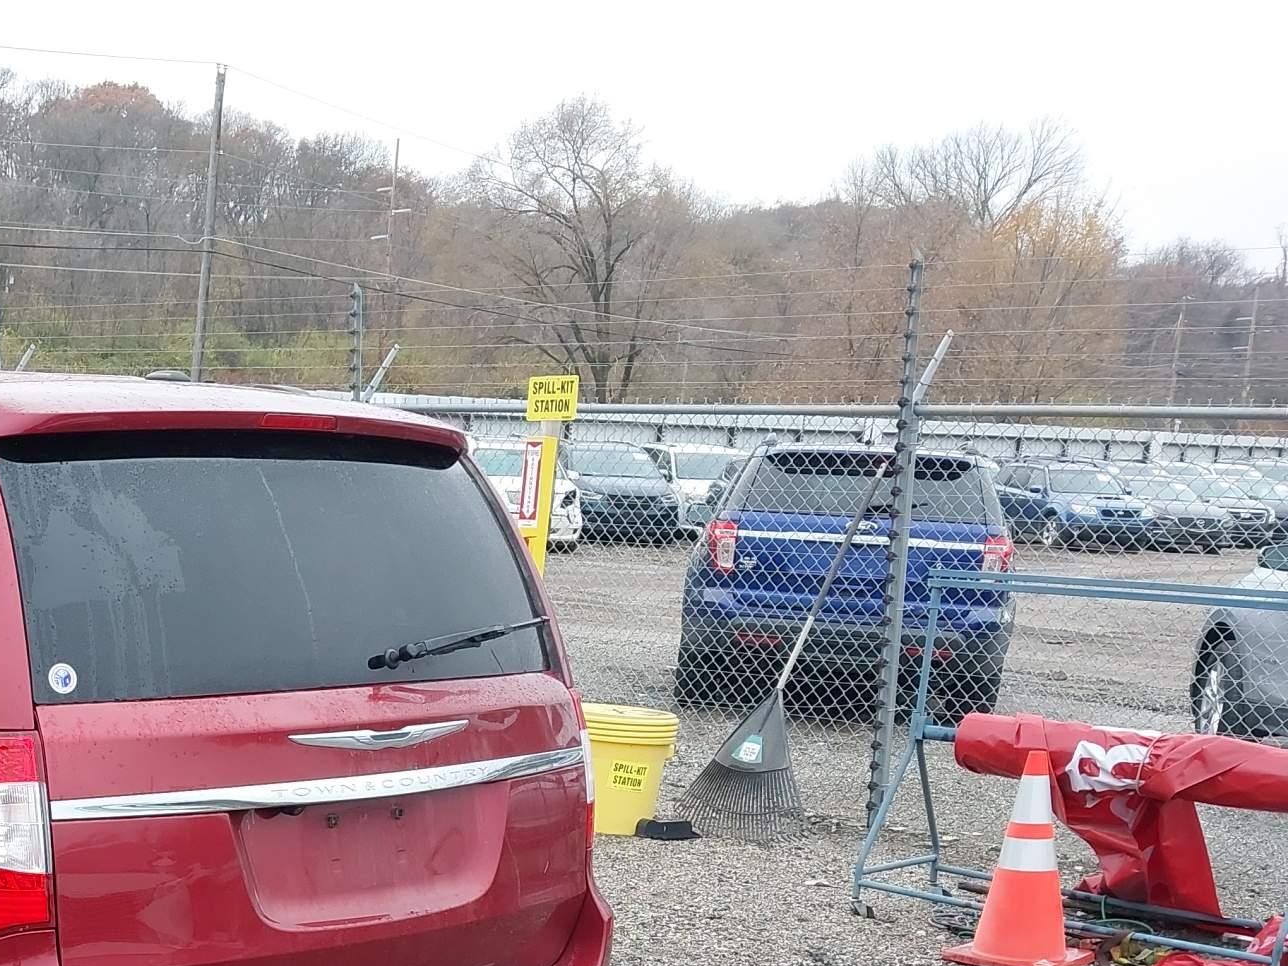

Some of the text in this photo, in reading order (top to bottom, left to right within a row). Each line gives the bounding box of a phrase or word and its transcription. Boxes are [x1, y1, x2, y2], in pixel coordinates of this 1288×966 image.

[532, 380, 575, 394] SPILL-KIT
[533, 398, 570, 413] STATION
[613, 762, 648, 776] SPILL-KIT
[270, 783, 356, 798] TOWN
[381, 766, 489, 789] COUNTRY
[612, 774, 643, 787] STATION
